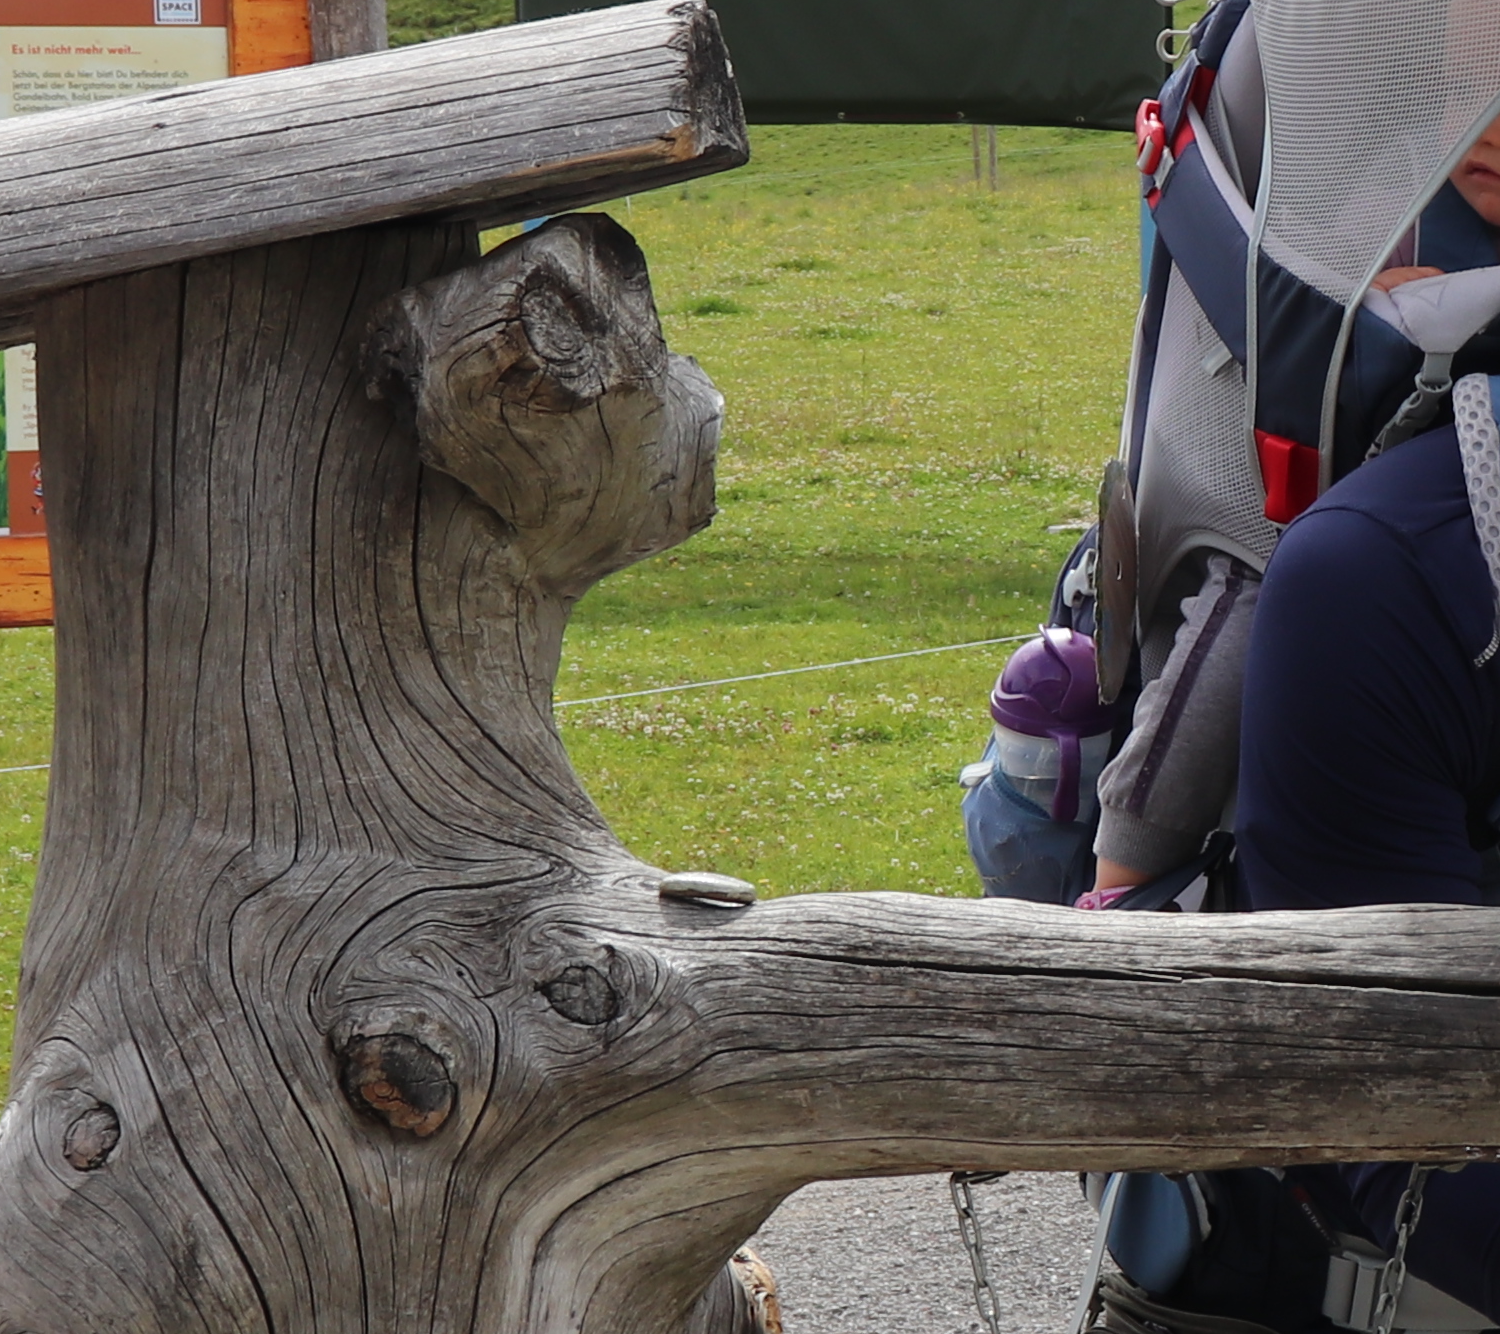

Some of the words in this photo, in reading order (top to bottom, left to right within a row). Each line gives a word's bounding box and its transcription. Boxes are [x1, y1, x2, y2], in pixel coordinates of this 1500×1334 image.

[161, 2, 193, 11] SPACE
[11, 44, 23, 55] Es
[27, 44, 41, 55] ist
[44, 44, 72, 55] nicht
[75, 44, 103, 55] mehr
[64, 70, 76, 79] du
[77, 70, 94, 79] hier
[116, 70, 128, 79] Du
[130, 70, 169, 79] befindest
[171, 70, 189, 79] dich
[50, 81, 66, 90] der
[68, 81, 115, 92] Bergstation
[118, 81, 133, 90] der
